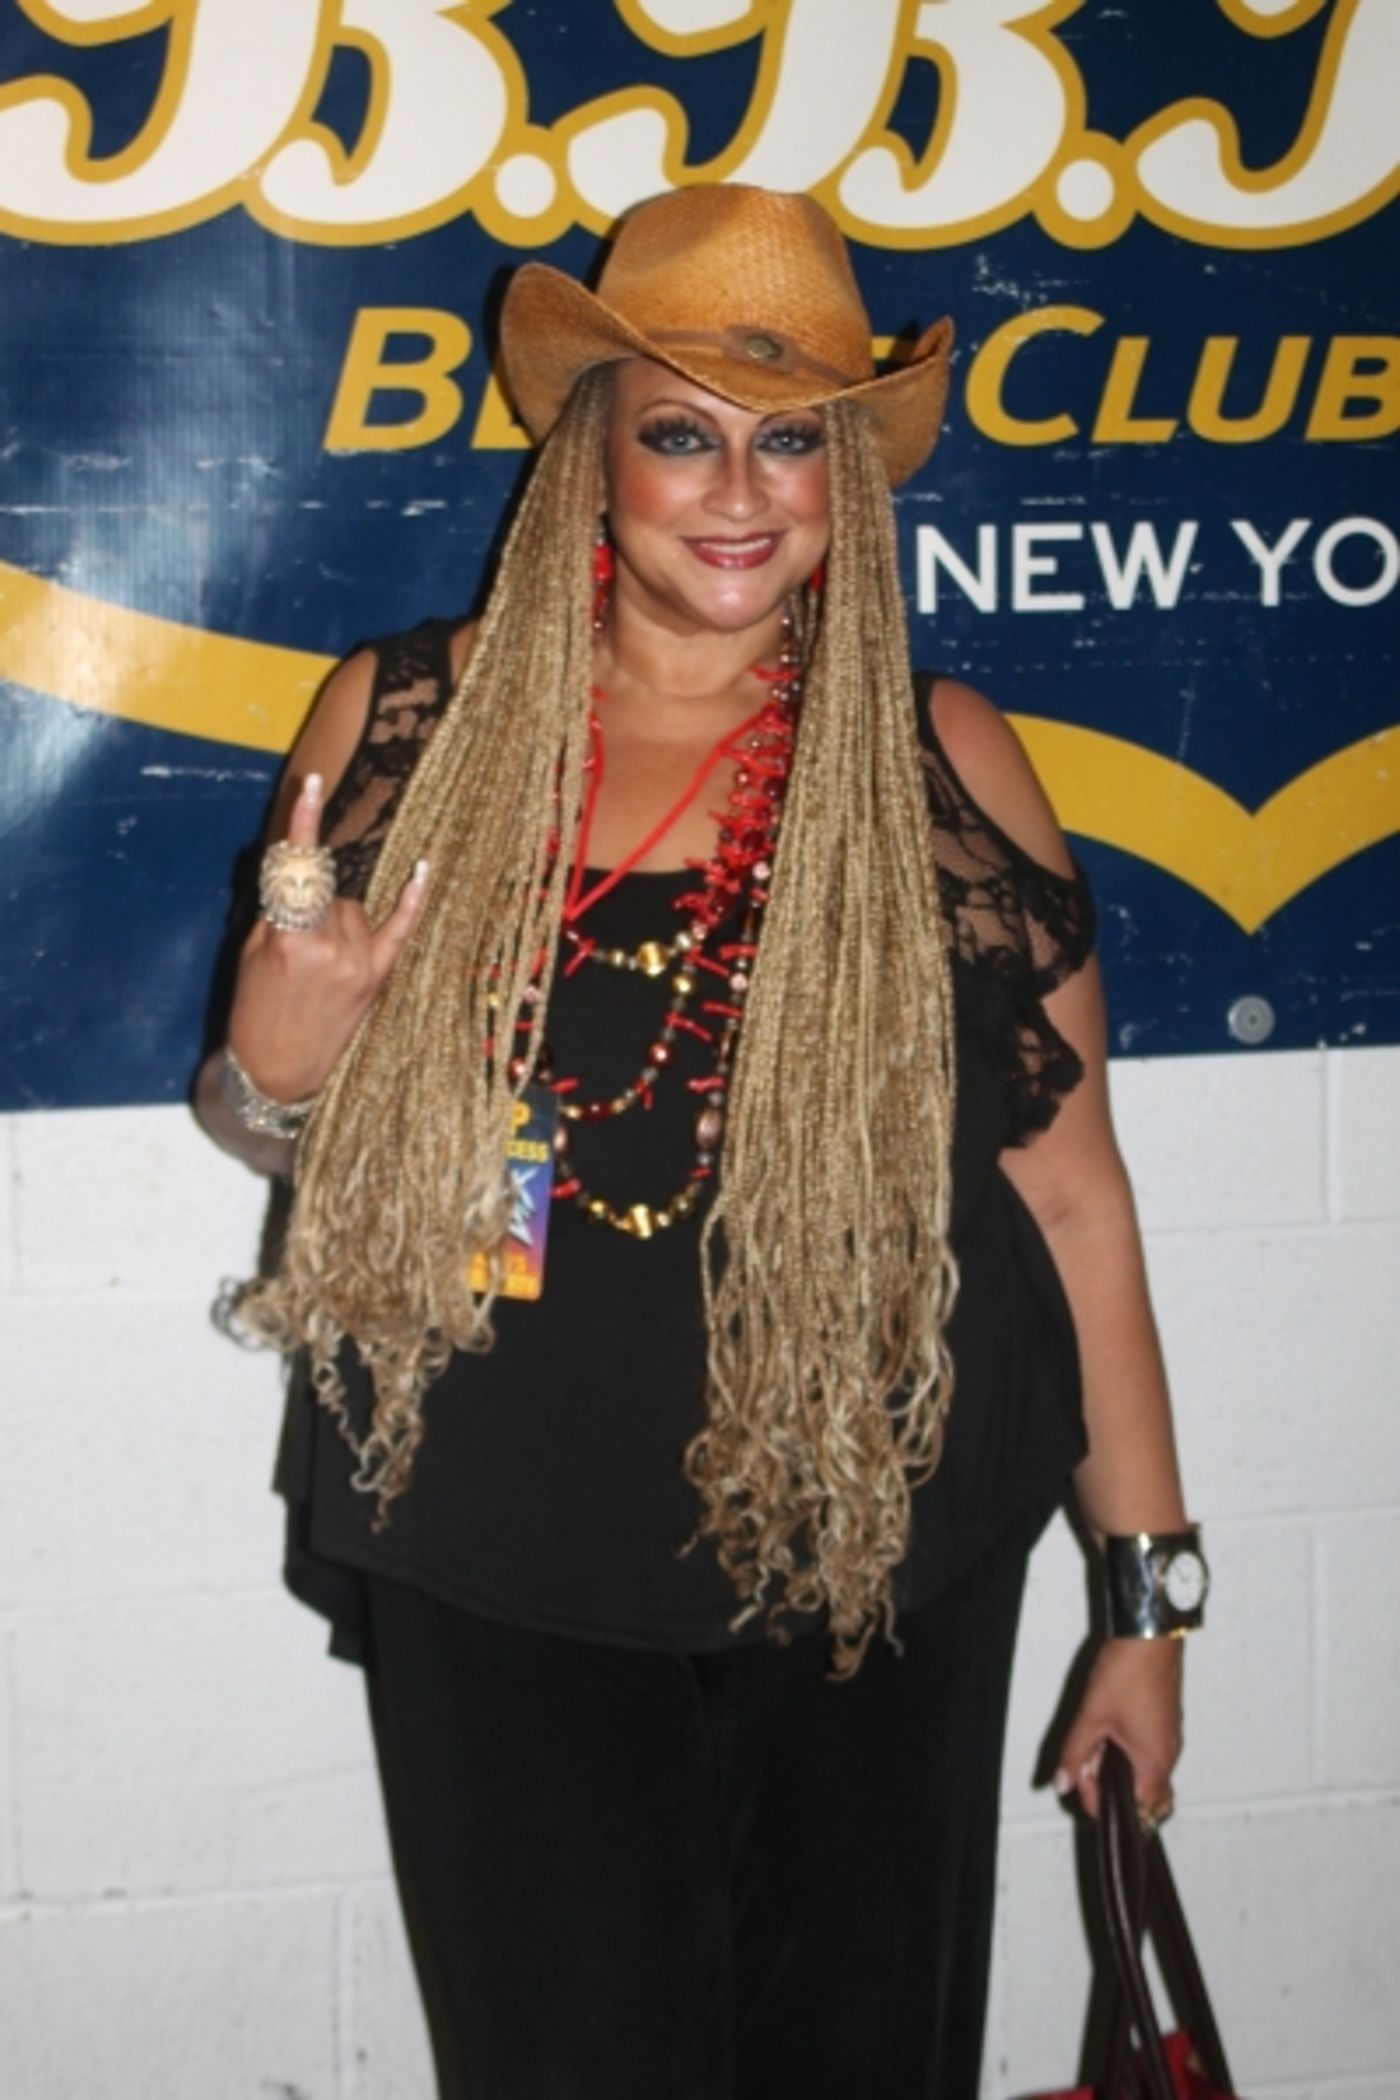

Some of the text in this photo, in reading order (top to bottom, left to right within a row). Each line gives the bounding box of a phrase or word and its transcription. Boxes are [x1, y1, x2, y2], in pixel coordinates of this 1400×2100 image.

[965, 305, 1400, 446] CLUB
[916, 516, 1400, 614] NEW YO
